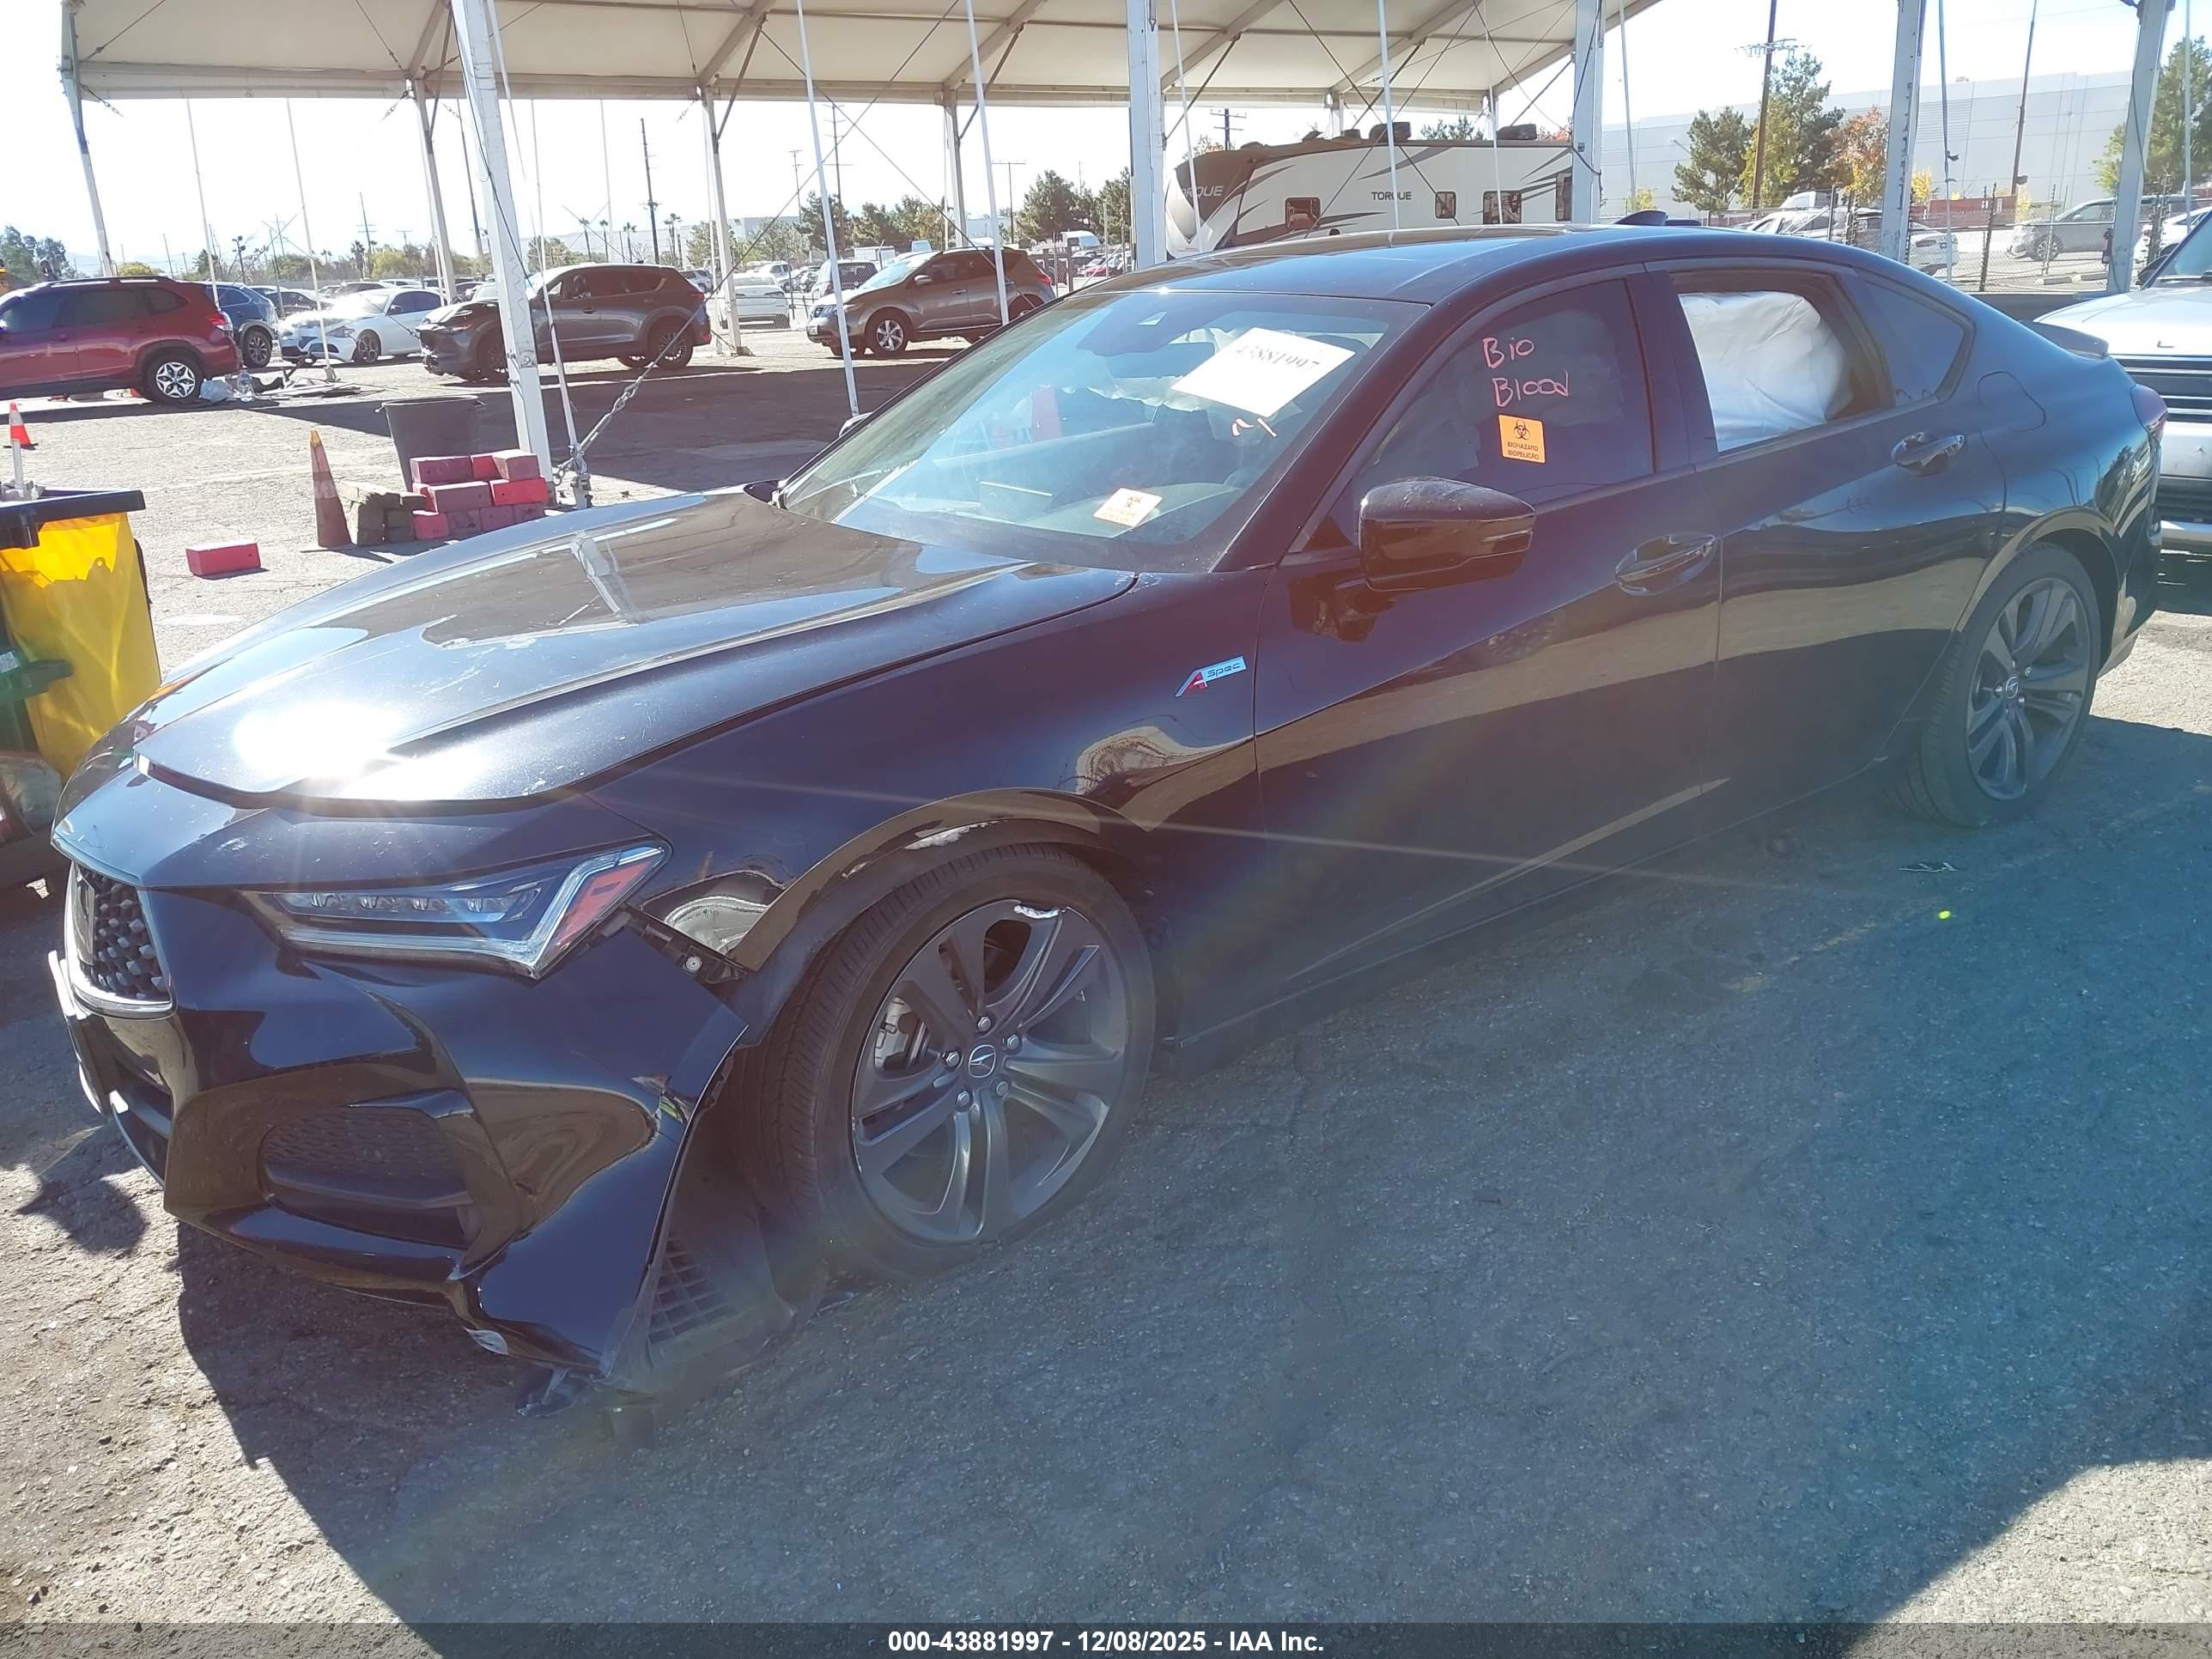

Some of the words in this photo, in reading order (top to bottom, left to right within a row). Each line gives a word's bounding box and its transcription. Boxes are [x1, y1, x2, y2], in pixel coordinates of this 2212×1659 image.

[1178, 185, 1224, 199] ORQUE
[1482, 337, 1535, 369] Bio
[1492, 369, 1570, 408] Blood
[1507, 441, 1539, 451] BIOHAZARD
